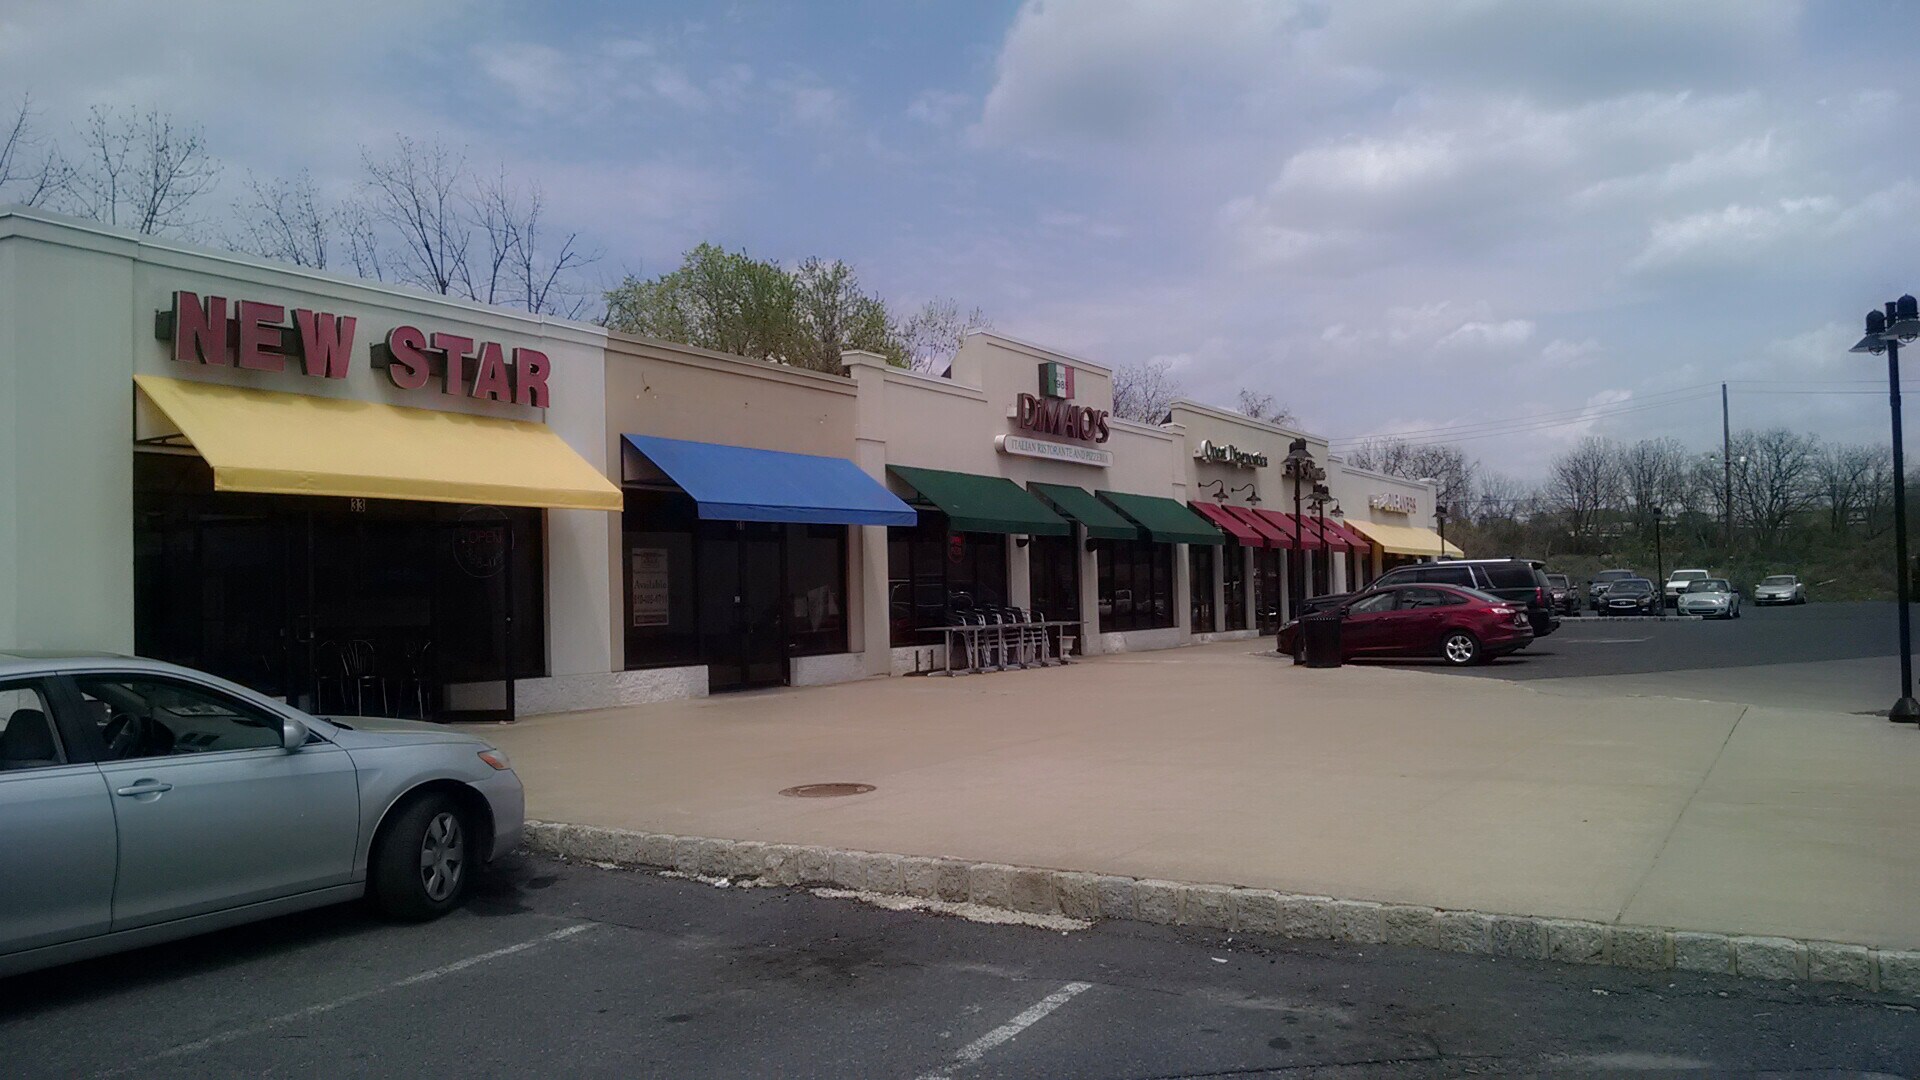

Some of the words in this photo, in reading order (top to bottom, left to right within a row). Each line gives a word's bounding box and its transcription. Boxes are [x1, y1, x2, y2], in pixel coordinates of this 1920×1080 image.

[172, 290, 357, 379] NEW
[387, 325, 551, 408] STAR
[1011, 440, 1036, 452] ITALIAN
[1037, 443, 1073, 458] RISTORANTE
[351, 499, 365, 512] 33
[468, 529, 504, 544] OPEN
